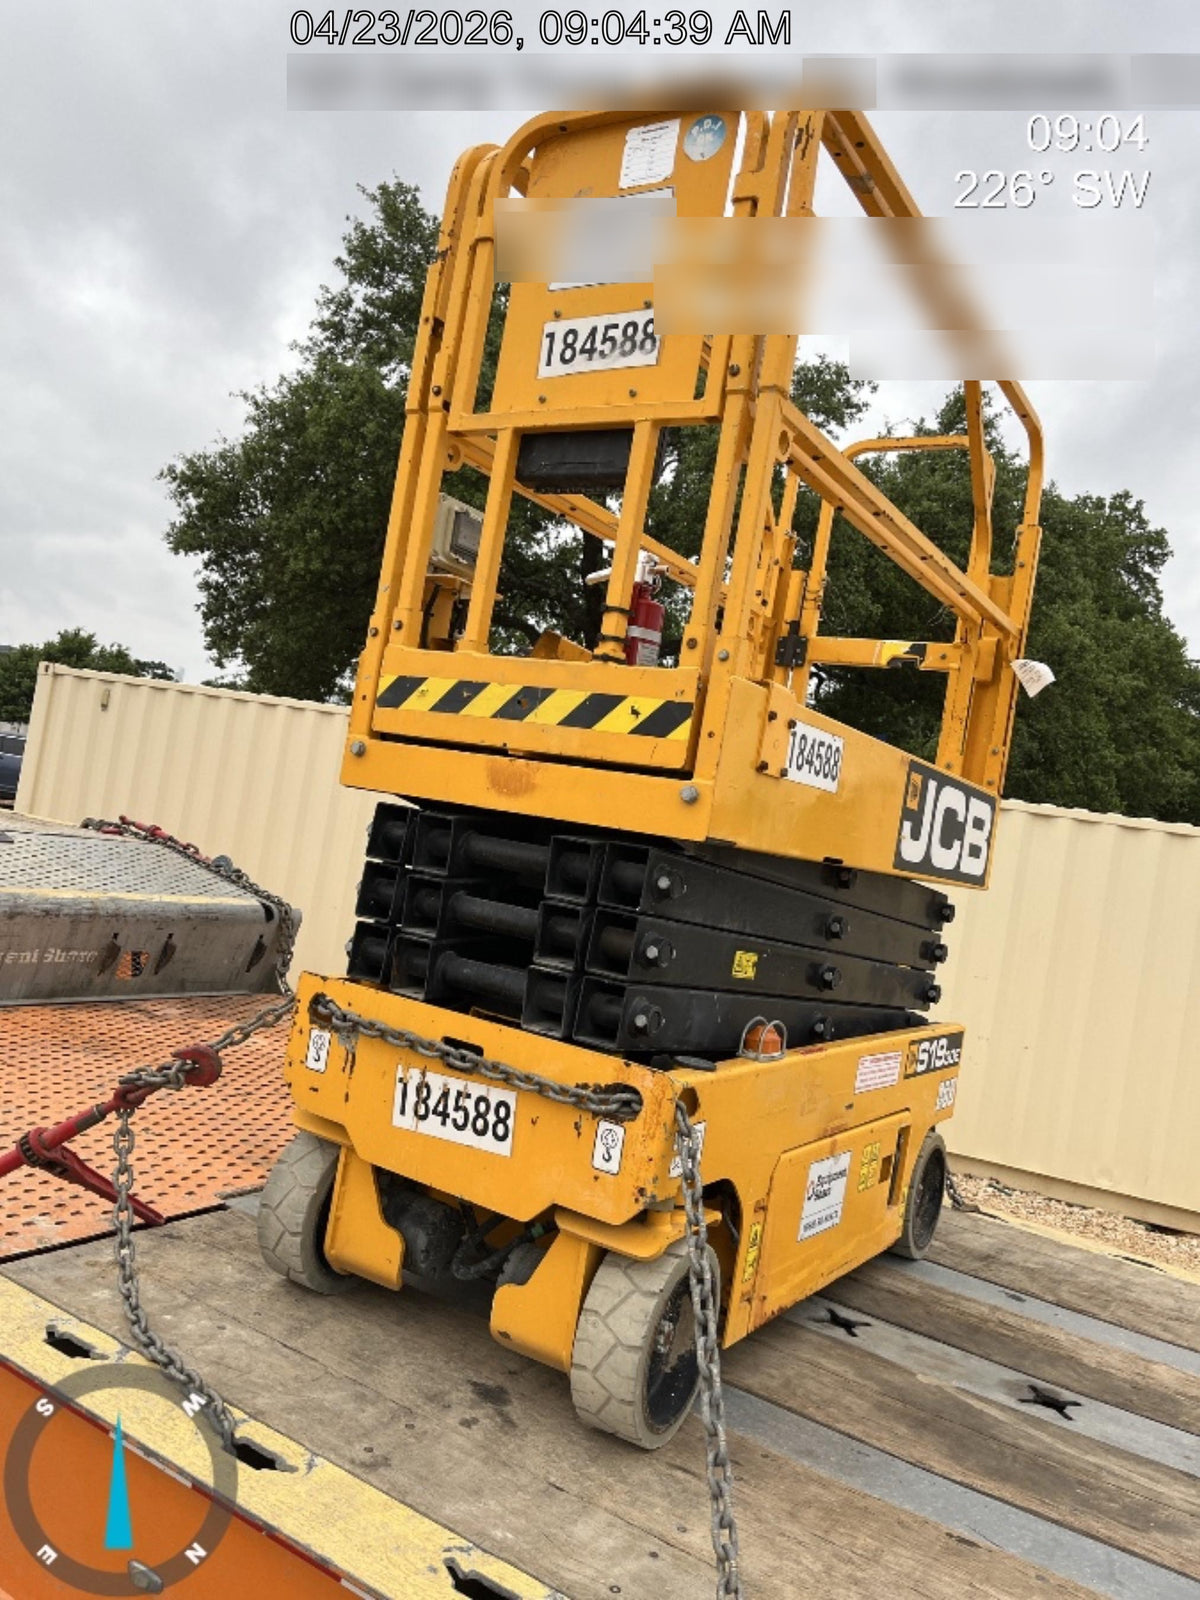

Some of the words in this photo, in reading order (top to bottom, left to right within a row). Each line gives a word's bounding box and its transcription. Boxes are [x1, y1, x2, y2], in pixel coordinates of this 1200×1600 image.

[545, 317, 657, 367] 184588
[788, 731, 842, 783] 184588
[900, 778, 992, 877] JCB
[397, 1076, 512, 1143] 184588
